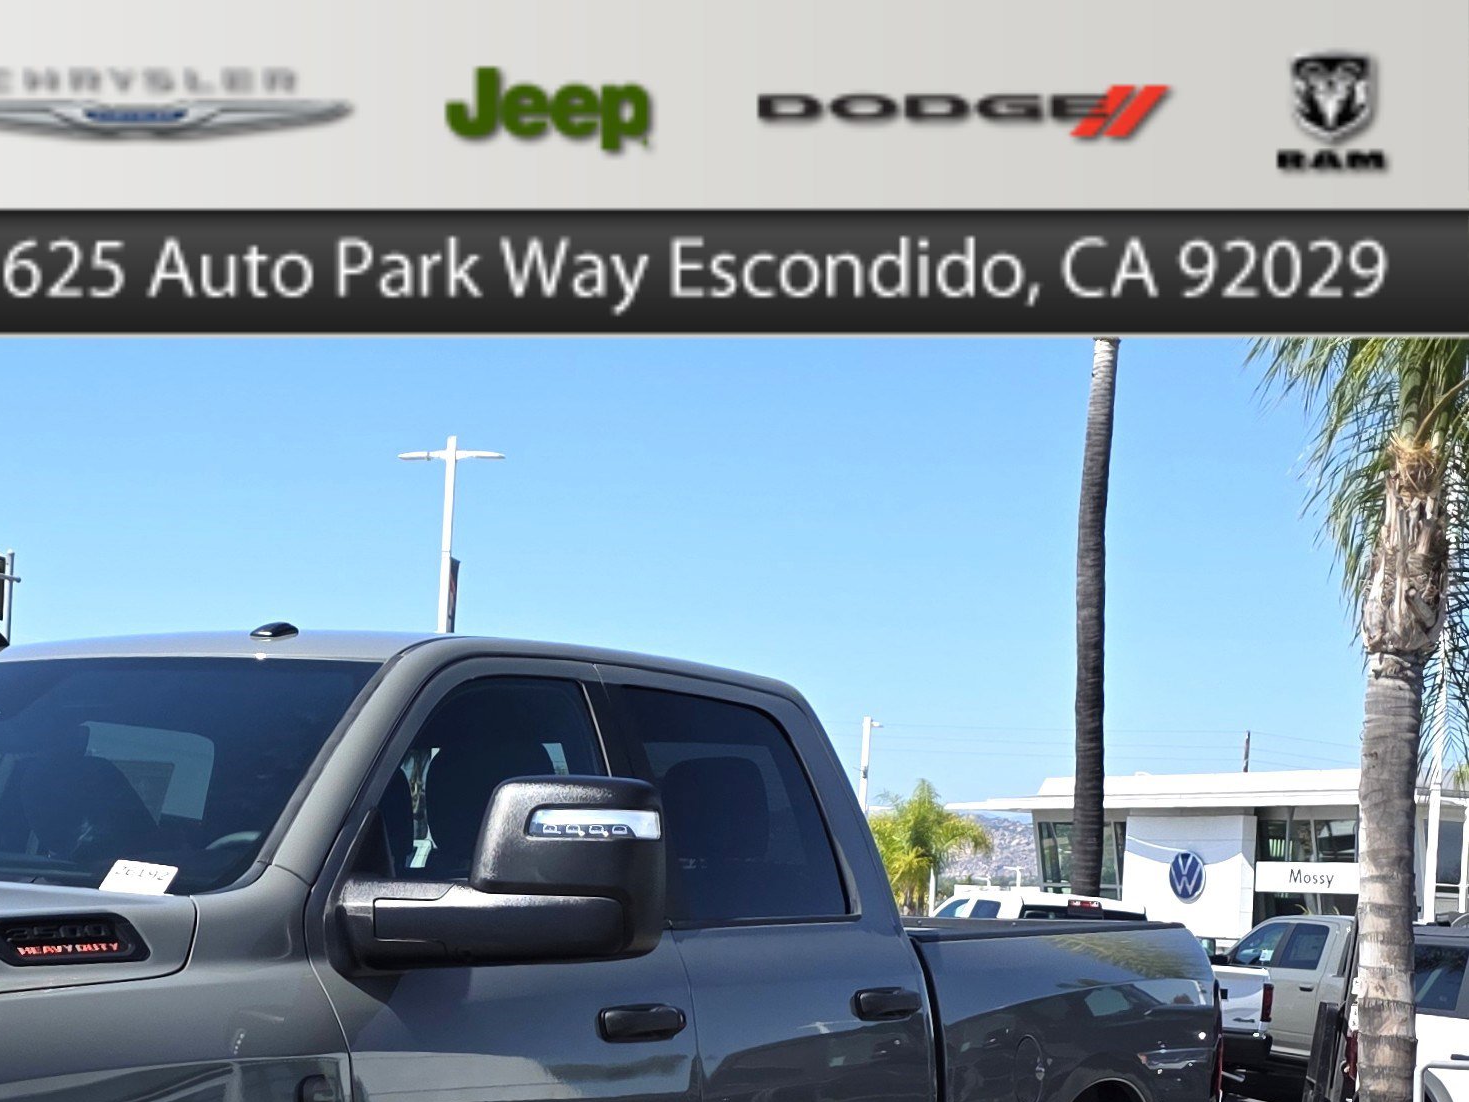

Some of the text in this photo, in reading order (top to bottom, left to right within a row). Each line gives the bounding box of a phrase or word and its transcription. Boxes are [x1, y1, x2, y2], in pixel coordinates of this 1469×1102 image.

[1288, 869, 1335, 888] Mossy
[17, 942, 119, 956] HEAVY DUTY
